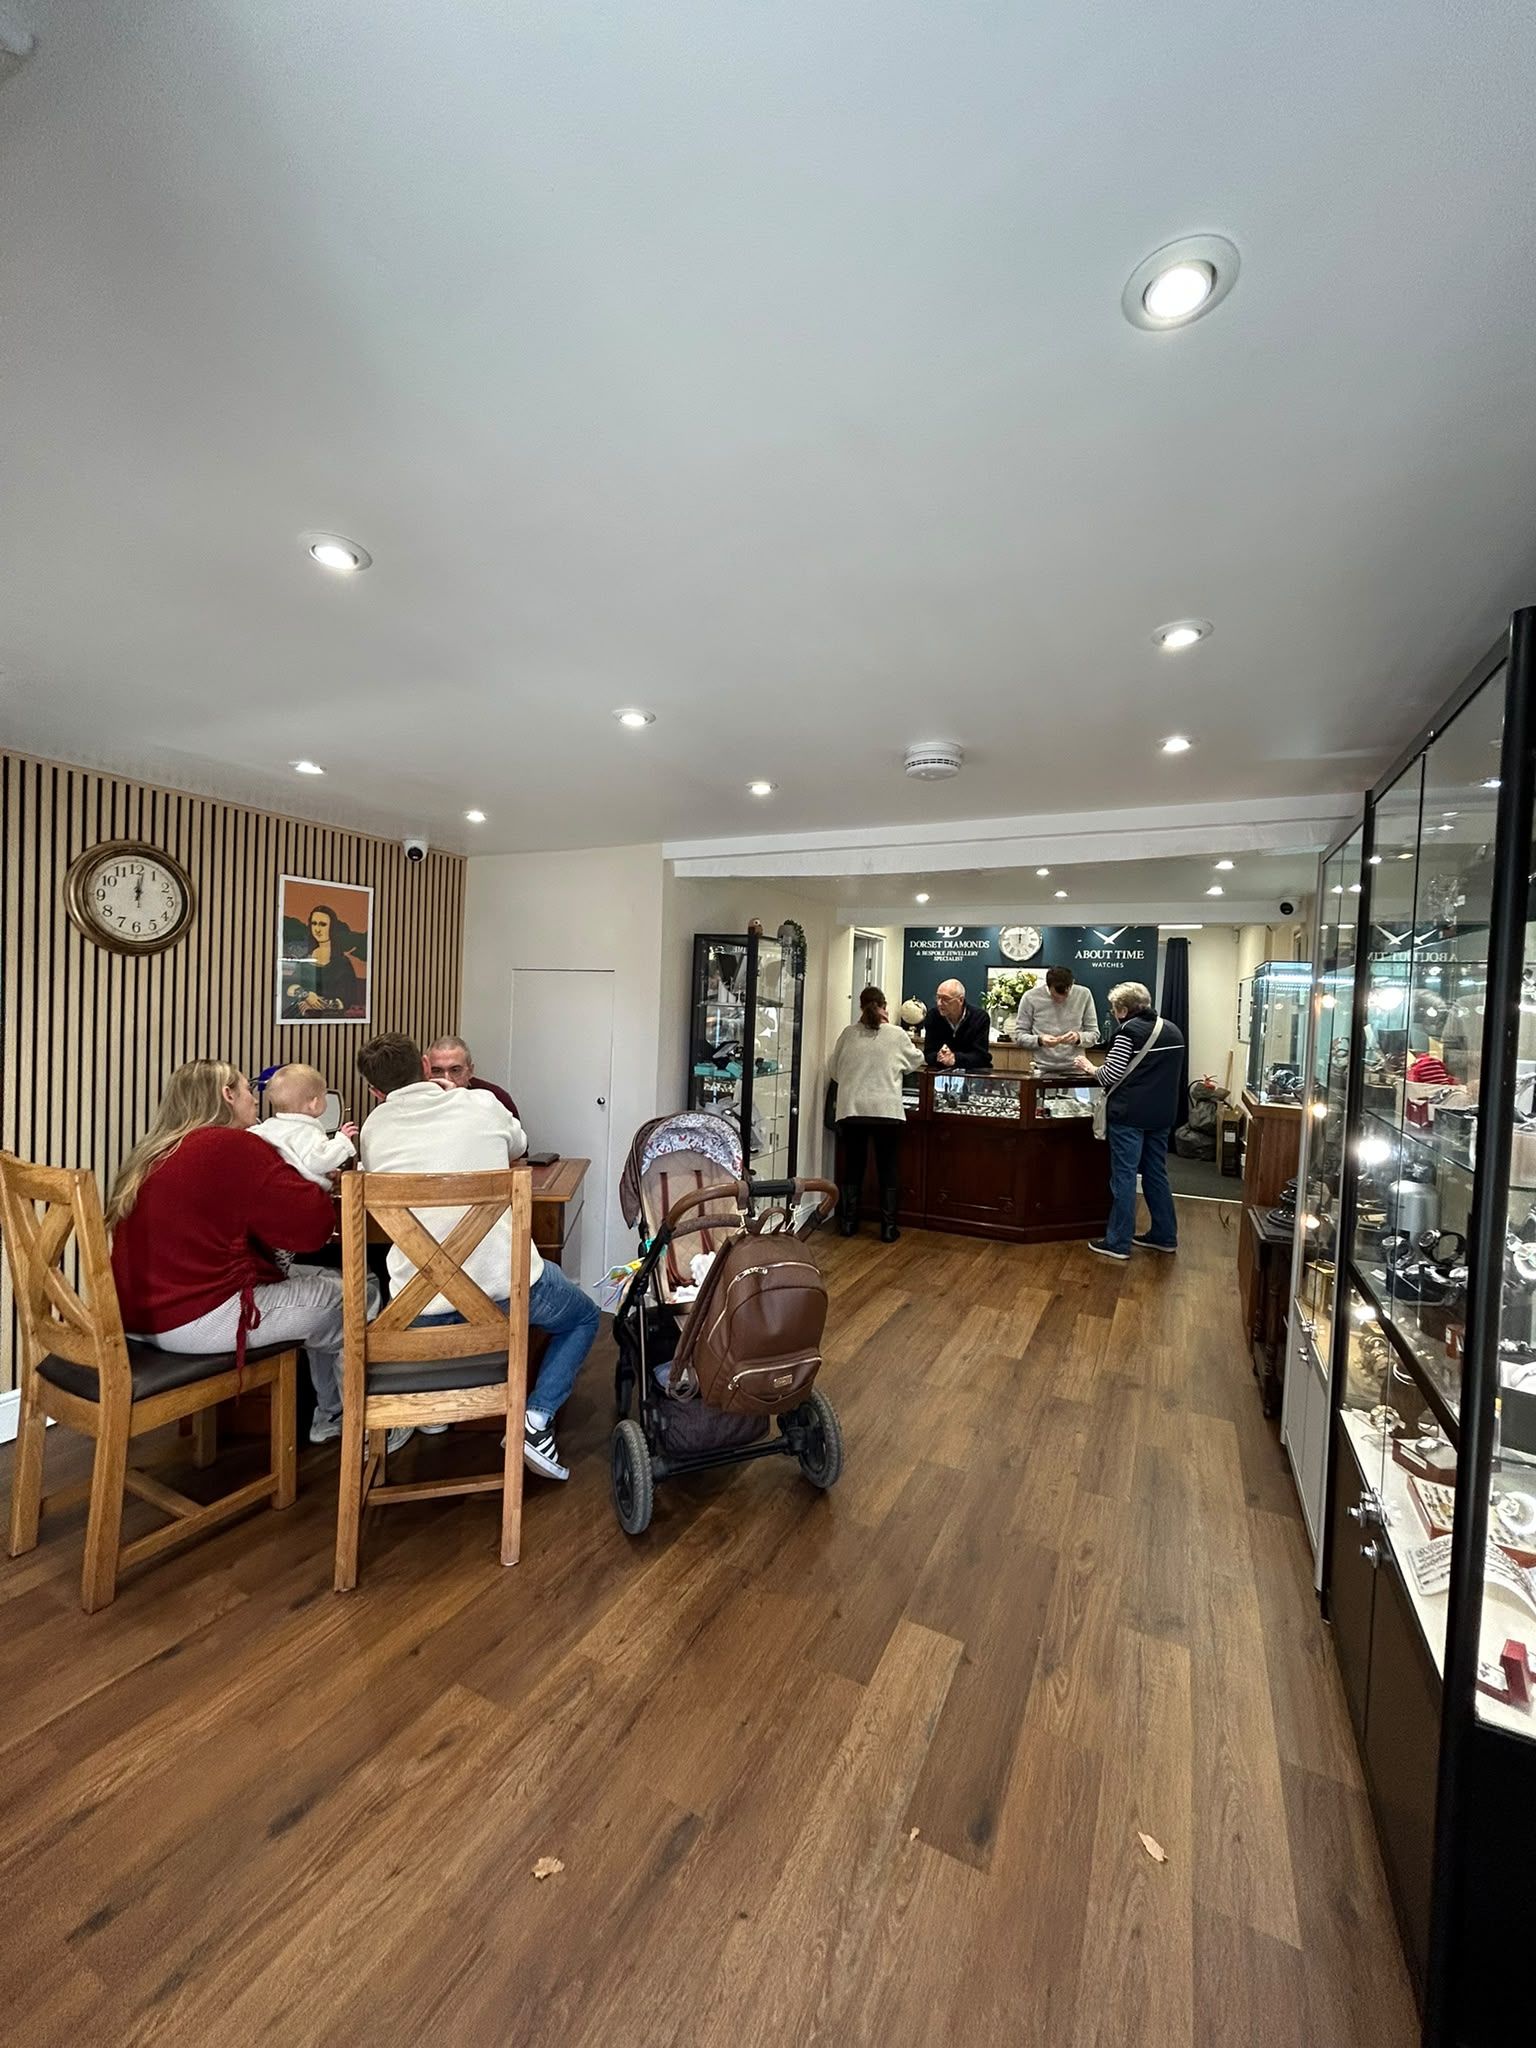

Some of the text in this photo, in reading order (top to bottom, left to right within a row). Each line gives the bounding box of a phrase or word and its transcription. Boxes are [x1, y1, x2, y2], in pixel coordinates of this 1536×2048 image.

[115, 866, 126, 878] 11
[130, 864, 145, 876] 12
[102, 875, 118, 887] 10
[161, 882, 170, 893] 2
[96, 888, 106, 901] 9
[166, 896, 174, 908] 3
[102, 905, 113, 917] 8
[161, 911, 169, 922] 4
[117, 916, 126, 928] 7
[132, 921, 141, 933] 6
[148, 919, 157, 931] 5
[944, 940, 990, 948] DIAMONDS
[1075, 950, 1144, 959] ABOUT TIME
